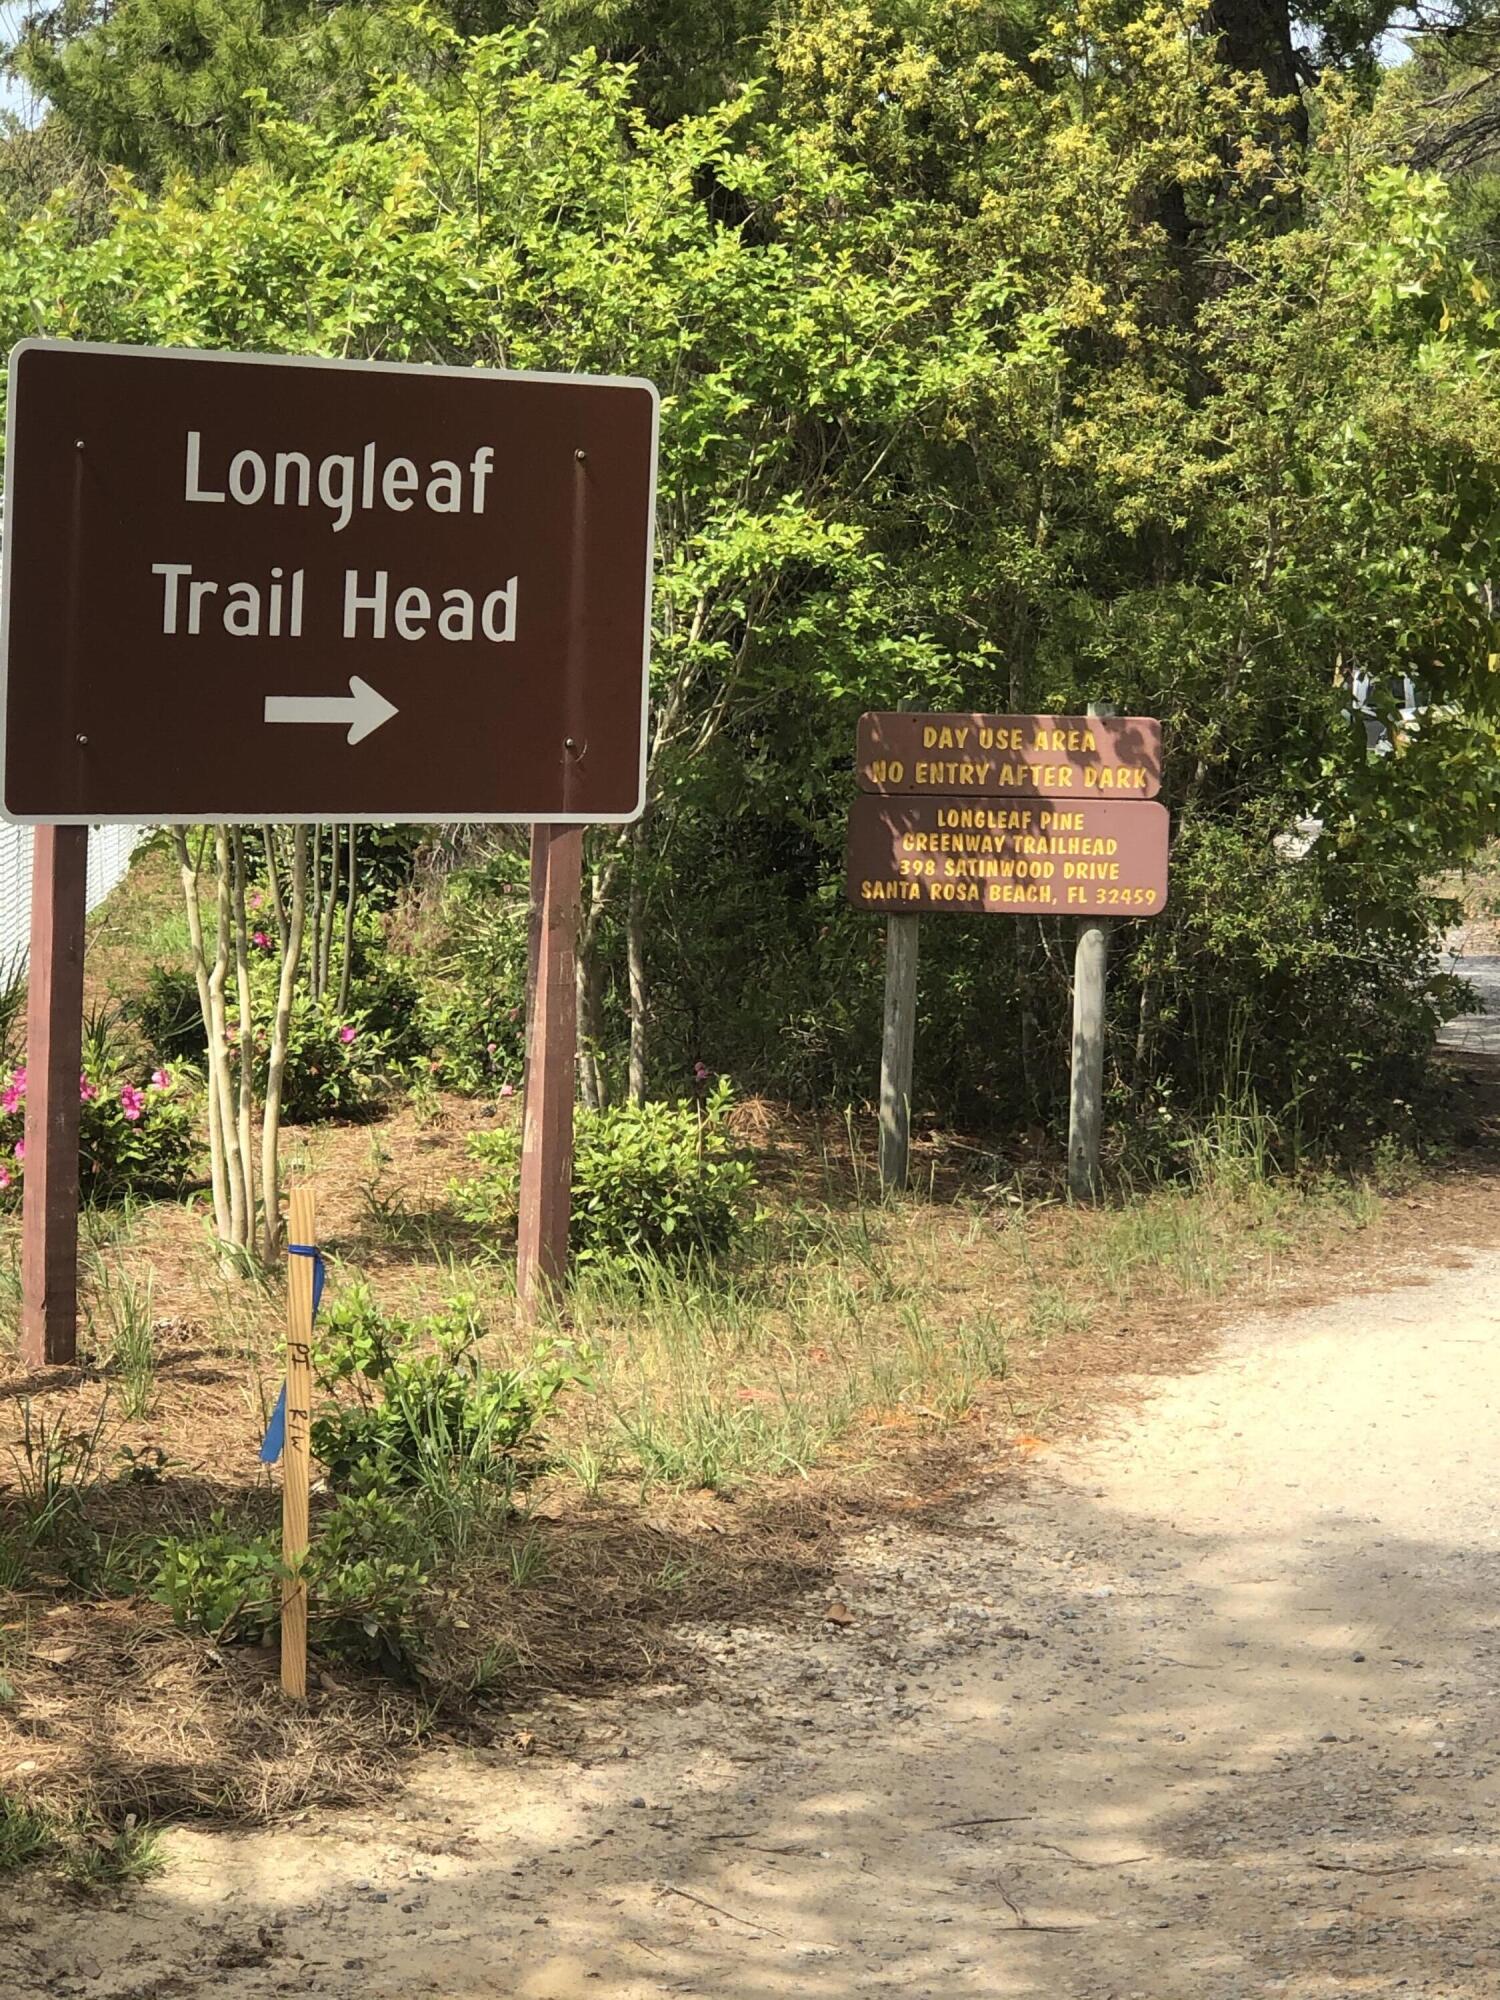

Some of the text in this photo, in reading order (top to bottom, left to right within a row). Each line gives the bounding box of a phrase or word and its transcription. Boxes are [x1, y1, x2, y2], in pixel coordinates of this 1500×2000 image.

[185, 431, 495, 532] Longleaf
[152, 564, 518, 642] Trail Head
[923, 725, 1096, 752] DAY USE AREA
[871, 760, 1147, 789] NO ENTRY AFTER DARK
[937, 809, 1084, 831] LONGLEAF PINE
[902, 832, 1118, 856] GREENWAY TRAILHEAD
[899, 859, 1120, 880] 398 SATINWOOD DRIVE
[861, 880, 1157, 906] SANTA ROSA BEACH, FL 32459
